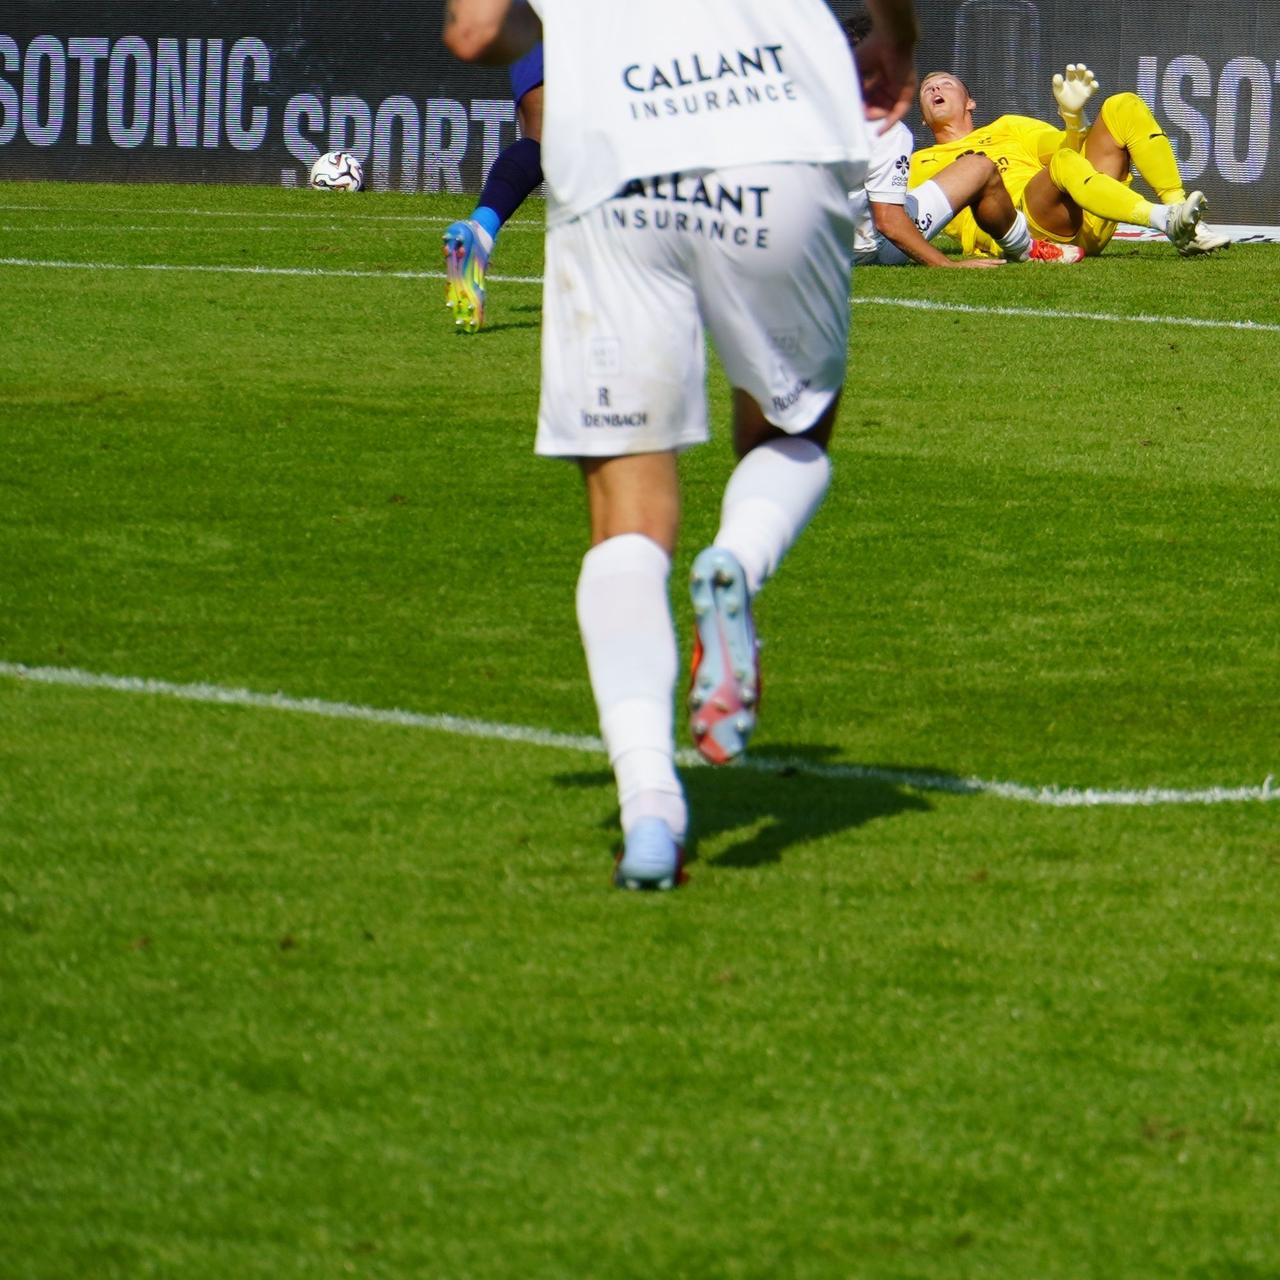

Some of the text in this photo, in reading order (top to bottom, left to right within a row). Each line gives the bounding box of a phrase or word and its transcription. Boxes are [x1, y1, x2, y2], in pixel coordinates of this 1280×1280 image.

[622, 44, 784, 95] CALLANT
[629, 81, 798, 119] INSURANCE
[281, 93, 516, 194] SPORT
[612, 172, 769, 219] ALLANT
[601, 209, 770, 249] INSURANCE
